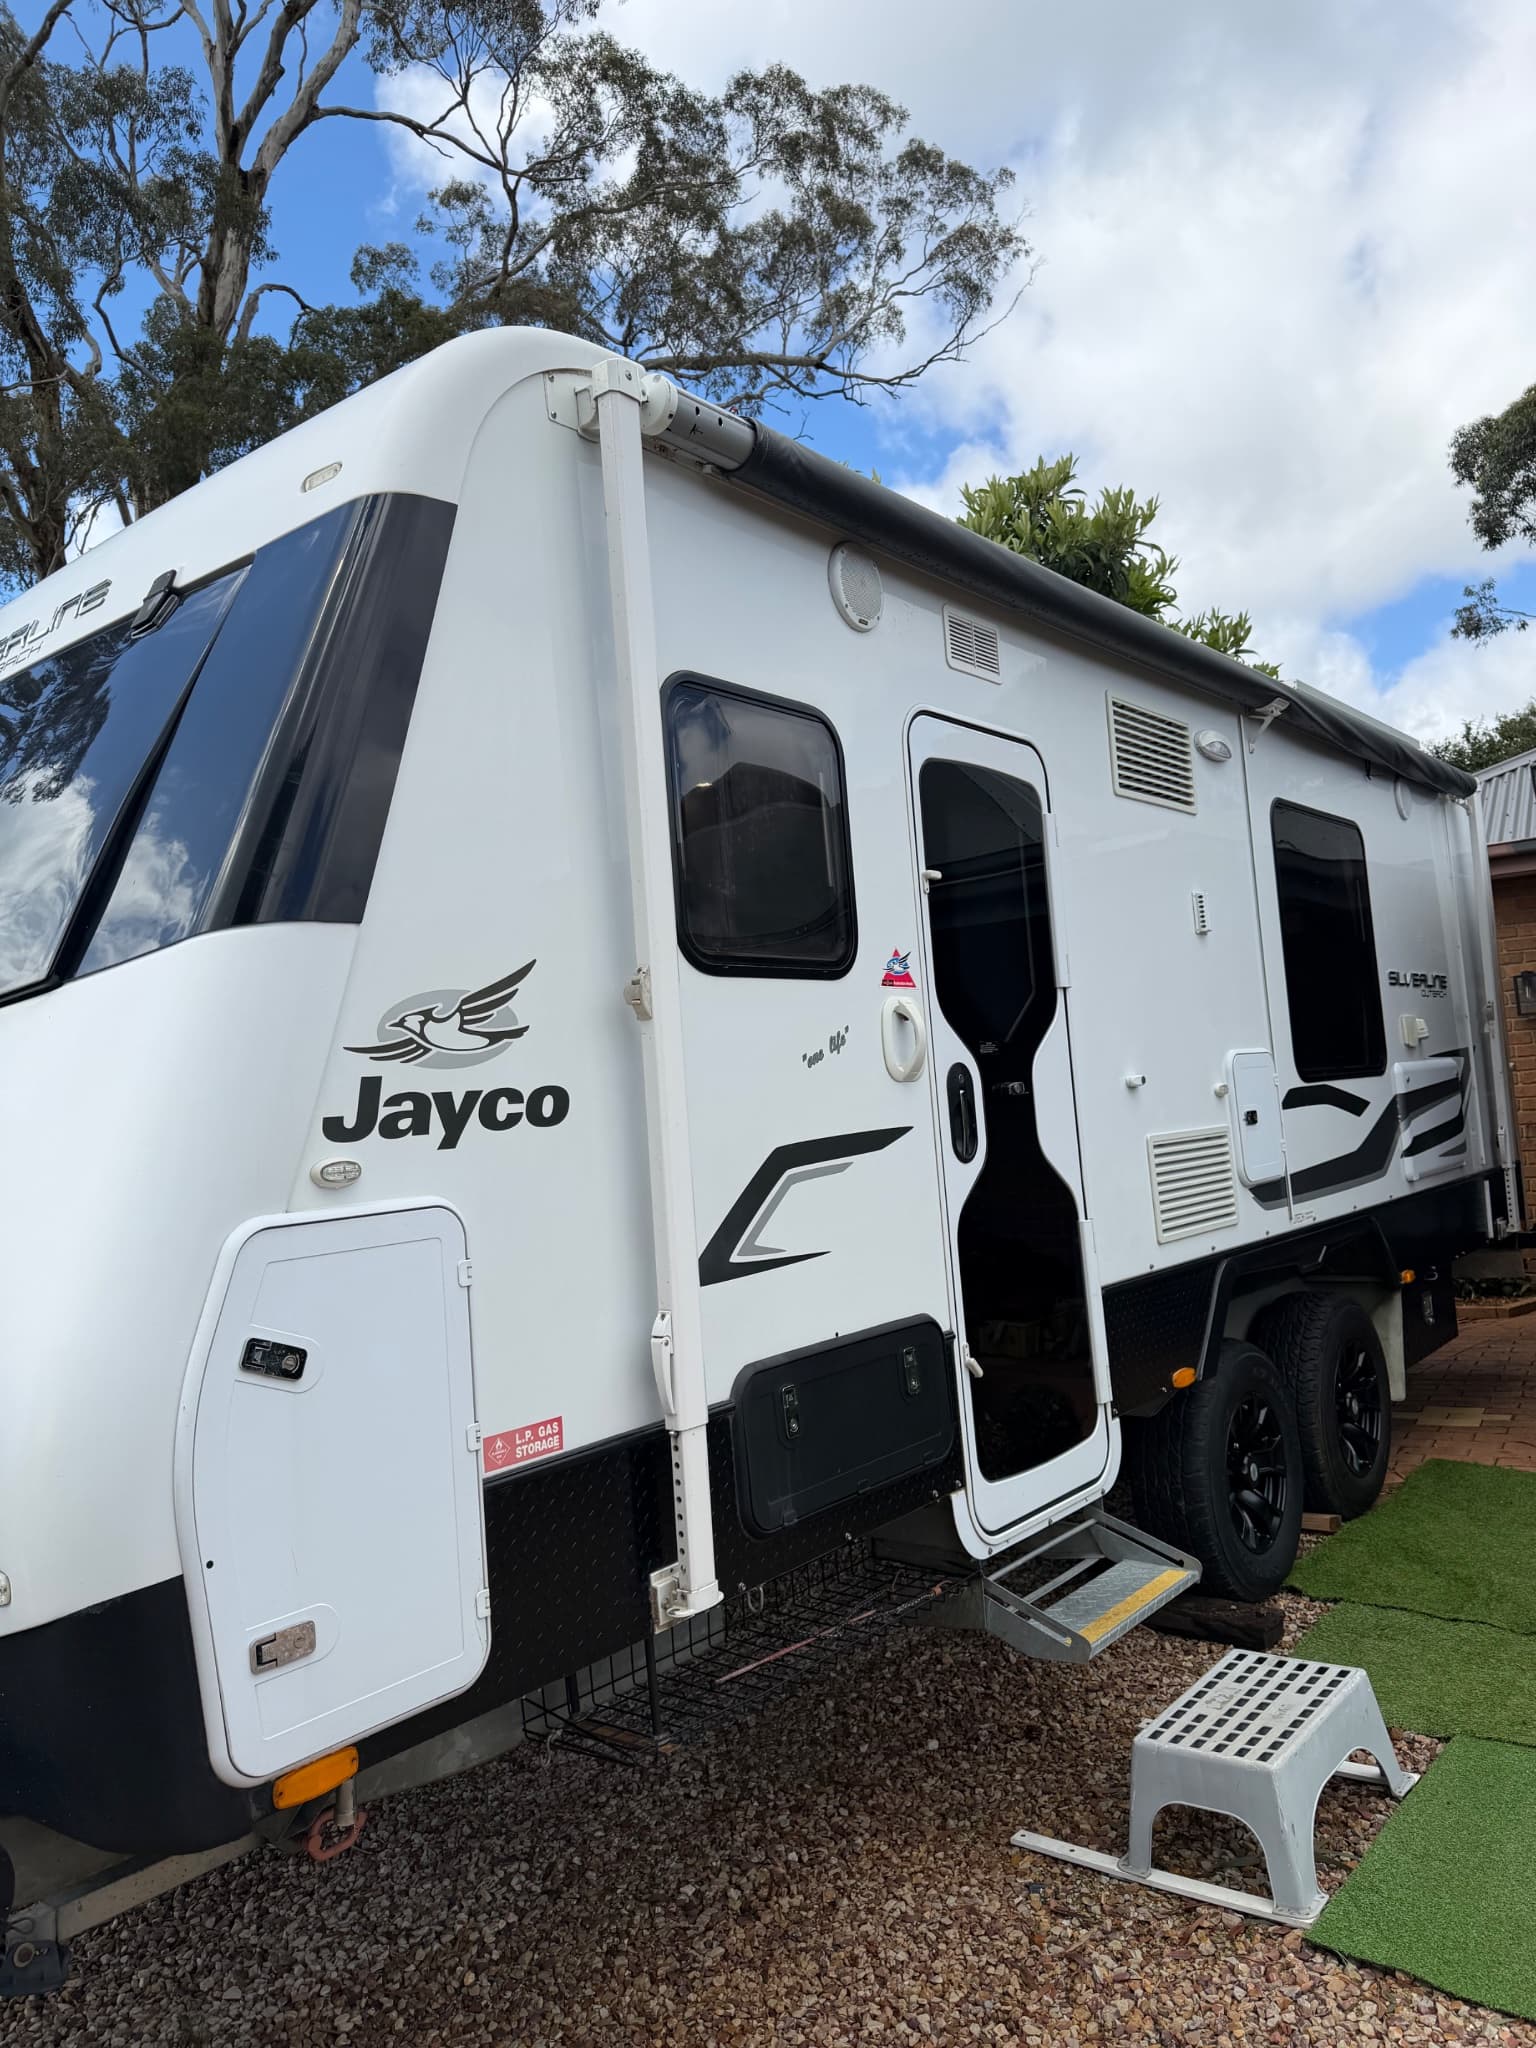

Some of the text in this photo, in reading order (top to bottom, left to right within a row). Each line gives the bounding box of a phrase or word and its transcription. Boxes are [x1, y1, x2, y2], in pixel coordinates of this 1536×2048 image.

[322, 1075, 570, 1150] Jayco
[515, 1421, 559, 1445] L.P. GAS
[515, 1434, 560, 1459] STORAGE
